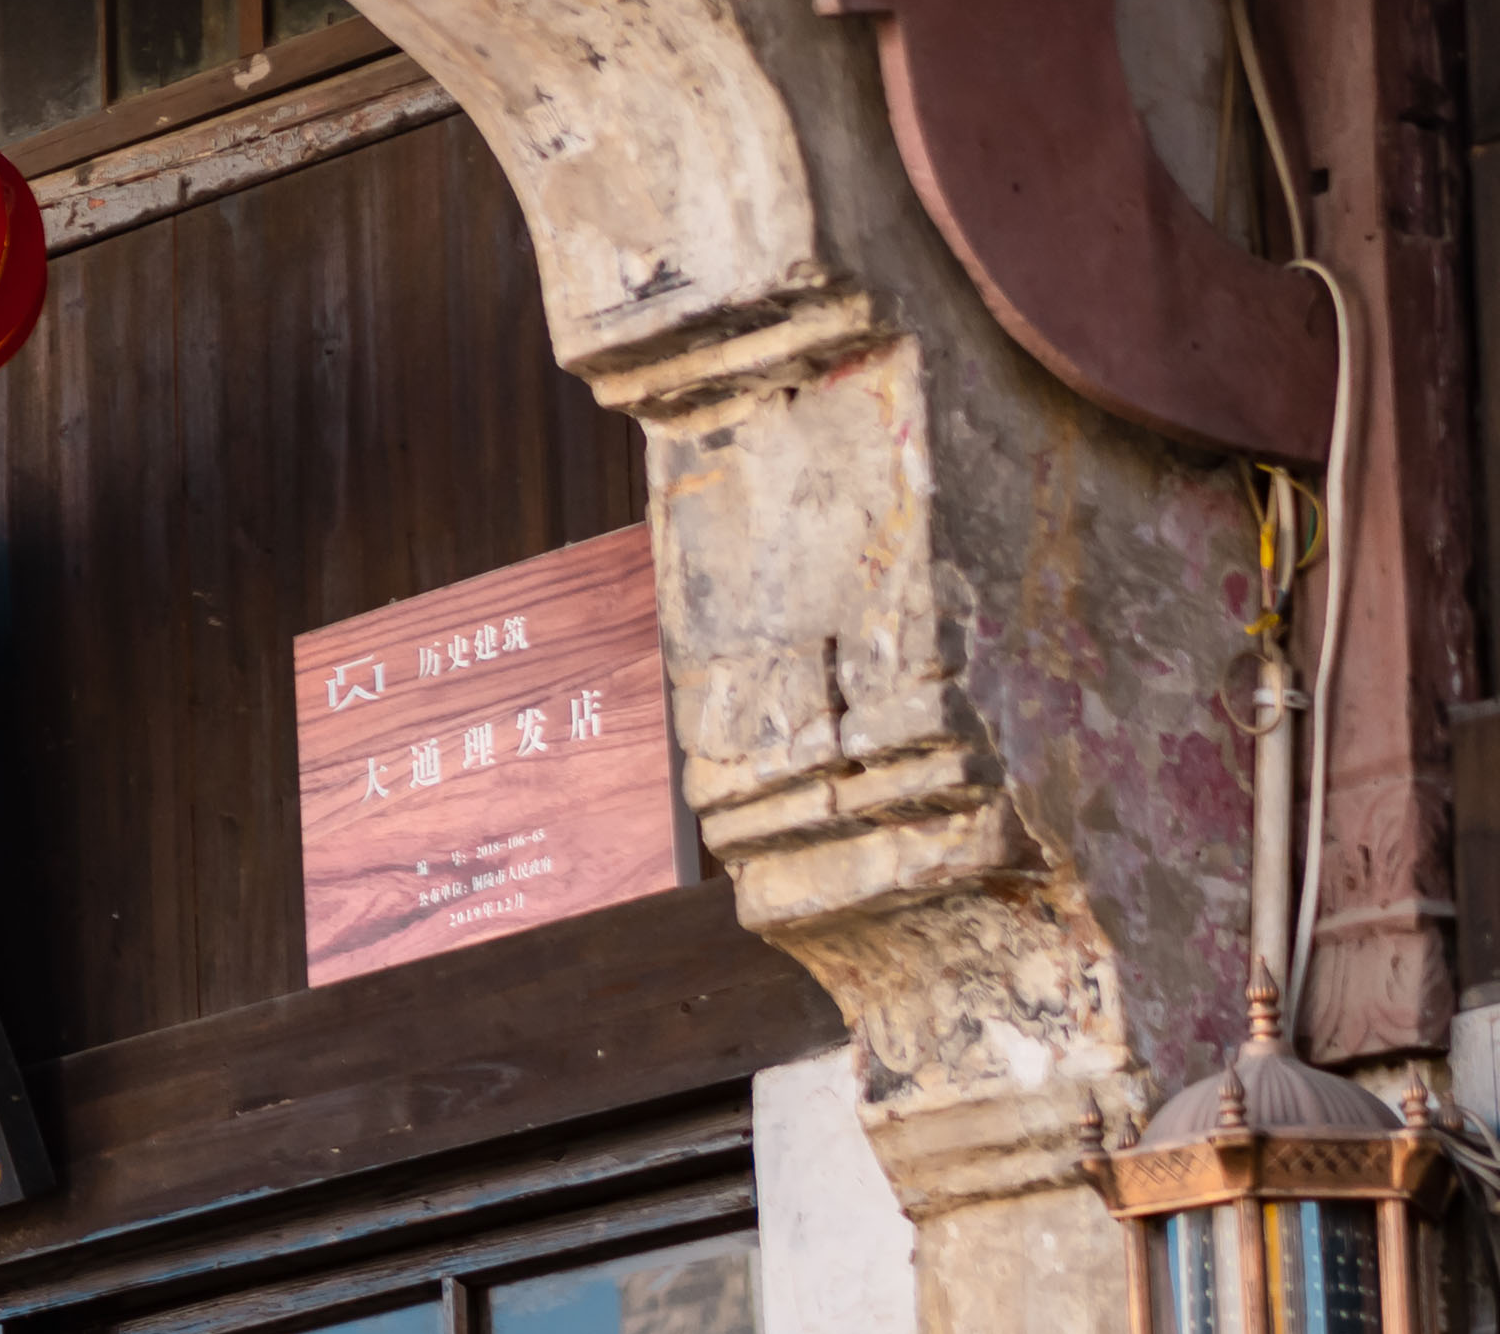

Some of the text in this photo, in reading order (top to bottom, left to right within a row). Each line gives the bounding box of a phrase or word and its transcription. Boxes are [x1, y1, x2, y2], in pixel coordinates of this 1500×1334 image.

[418, 616, 531, 679] 历史建筑
[361, 689, 603, 804] 大通理发店
